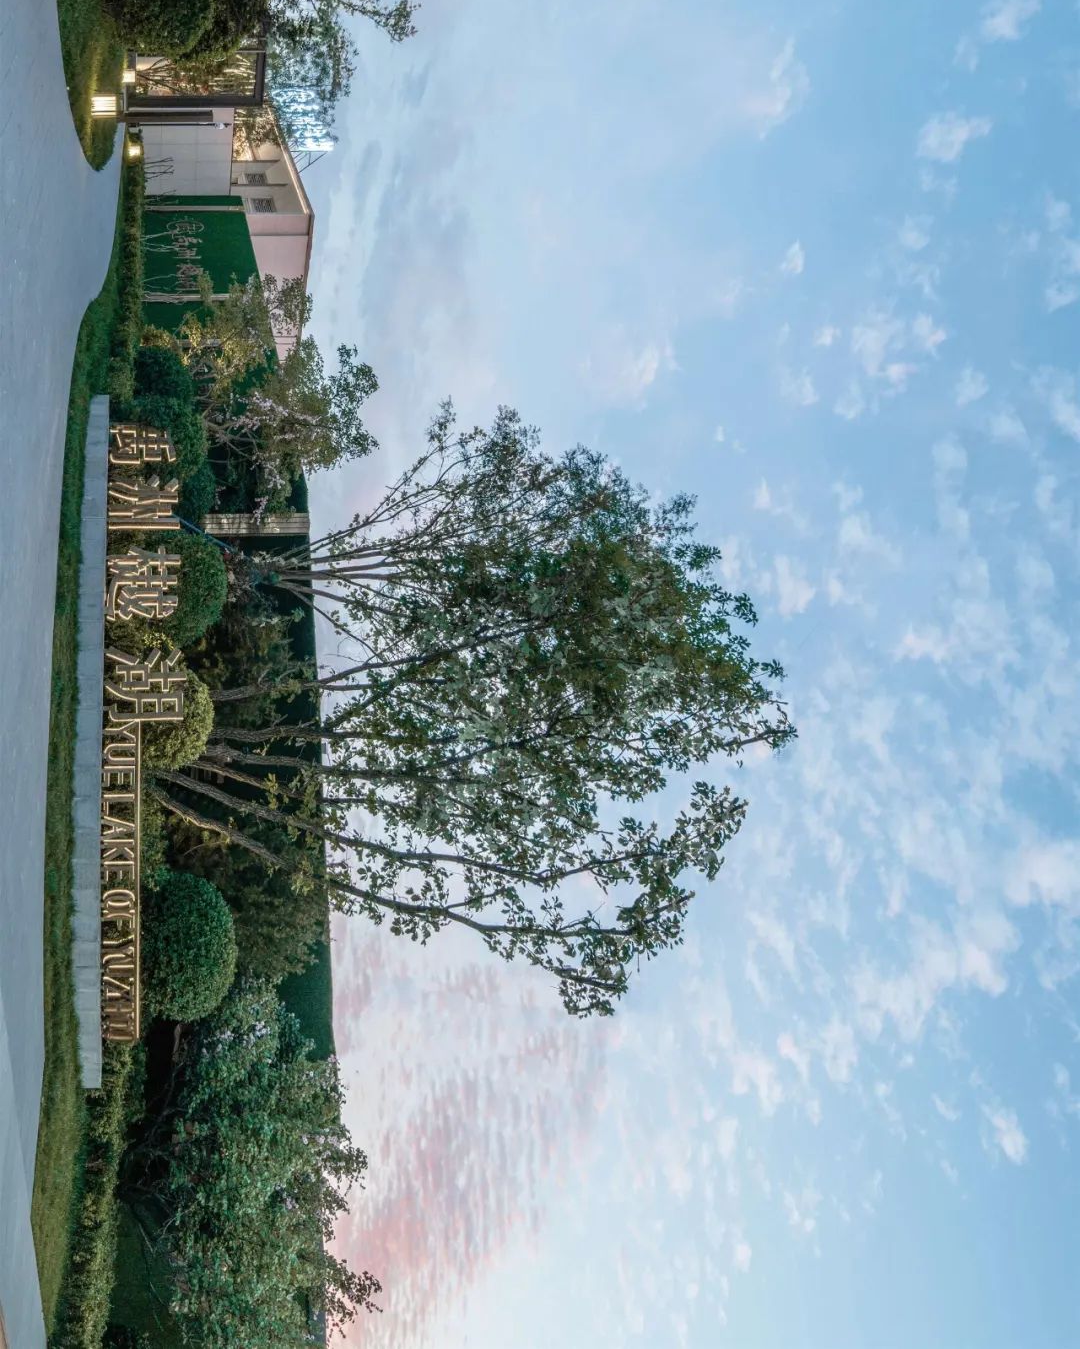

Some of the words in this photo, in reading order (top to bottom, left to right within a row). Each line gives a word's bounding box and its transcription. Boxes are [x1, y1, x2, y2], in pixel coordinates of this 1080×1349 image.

[103, 425, 186, 723] 禹洲樾湖
[101, 720, 137, 787] YUE
[101, 793, 137, 882] LAKE
